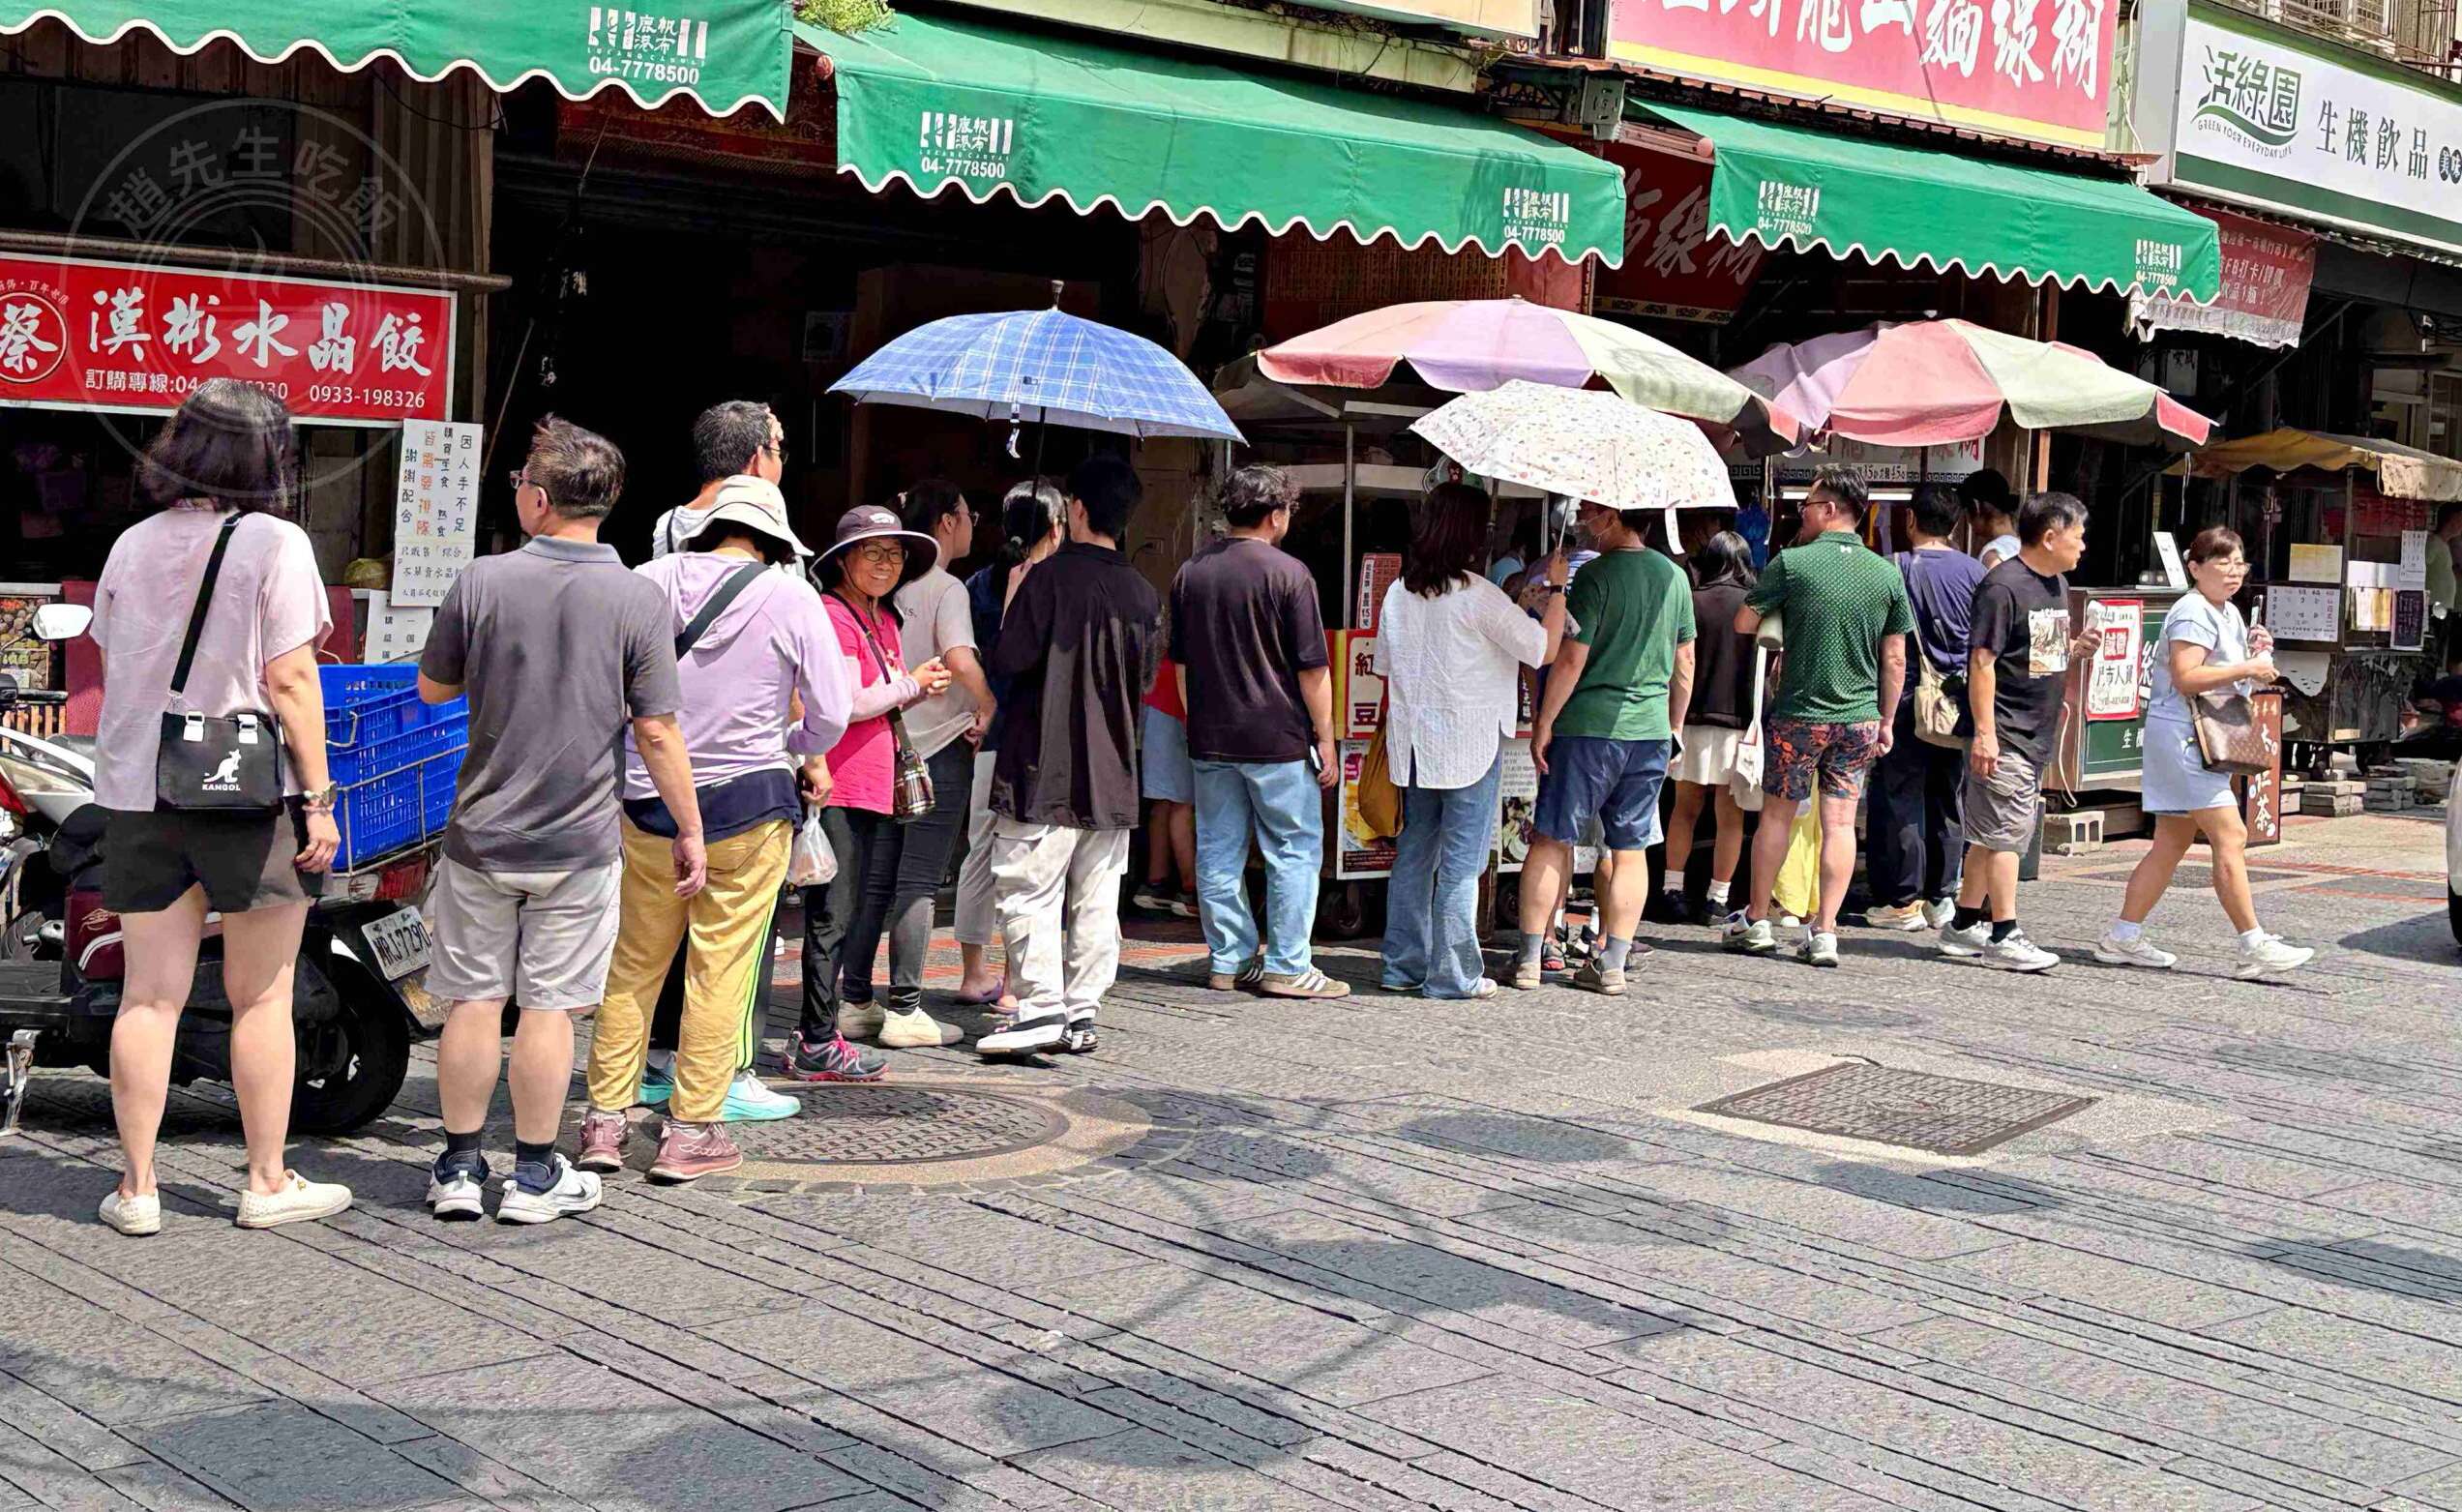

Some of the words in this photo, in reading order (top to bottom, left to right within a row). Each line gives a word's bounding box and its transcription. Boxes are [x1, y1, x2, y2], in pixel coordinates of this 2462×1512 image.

[589, 56, 699, 85] 04-7778500
[2198, 45, 2301, 132] 活綠園
[2198, 119, 2222, 133] GREEN
[2316, 100, 2428, 180] 生機飲品
[921, 157, 1005, 178] 04-7778500
[1503, 225, 1565, 243] 04-7778500
[1758, 216, 1812, 235] 04-7778500
[0, 303, 58, 373] 蔡
[89, 286, 431, 376] 漢彬水晶餃
[310, 385, 426, 409] 0933-198326
[400, 448, 418, 523] 謝謝配合
[454, 434, 472, 533] 因人手不足
